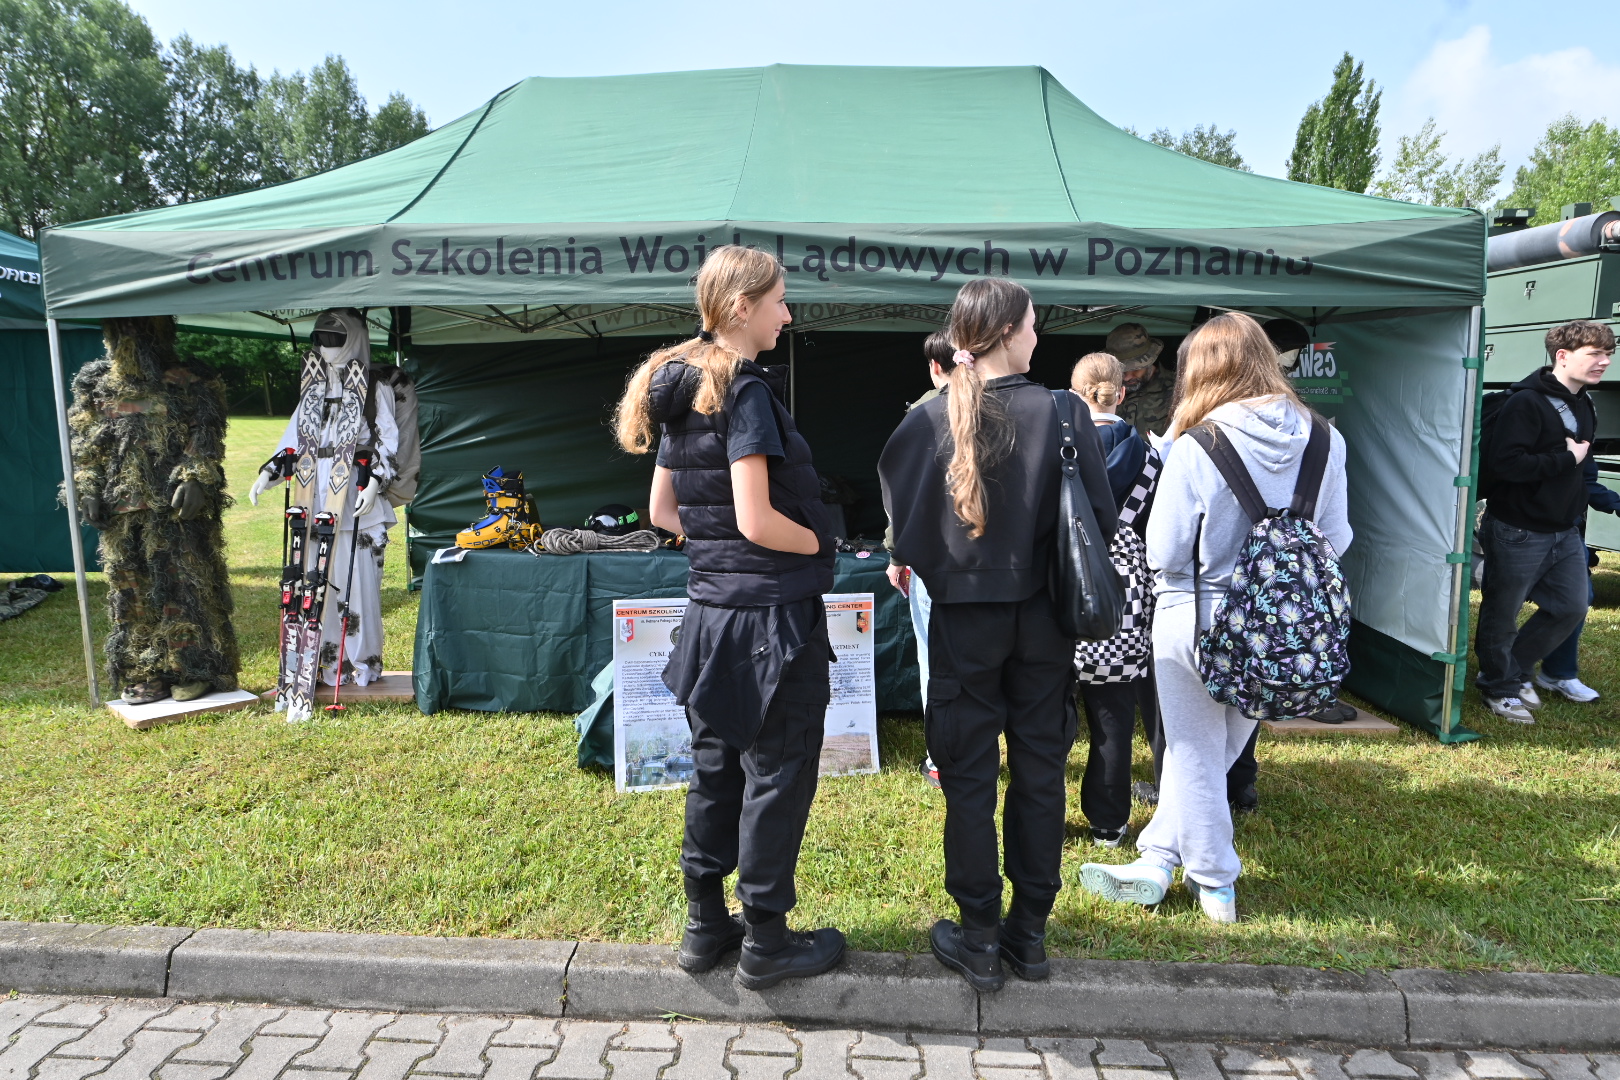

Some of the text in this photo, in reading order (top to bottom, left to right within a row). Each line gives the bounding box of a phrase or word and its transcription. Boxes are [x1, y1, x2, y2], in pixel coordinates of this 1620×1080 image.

[185, 234, 1314, 285] Centrum Szkolenia Woj Lądowych w Poznaniu
